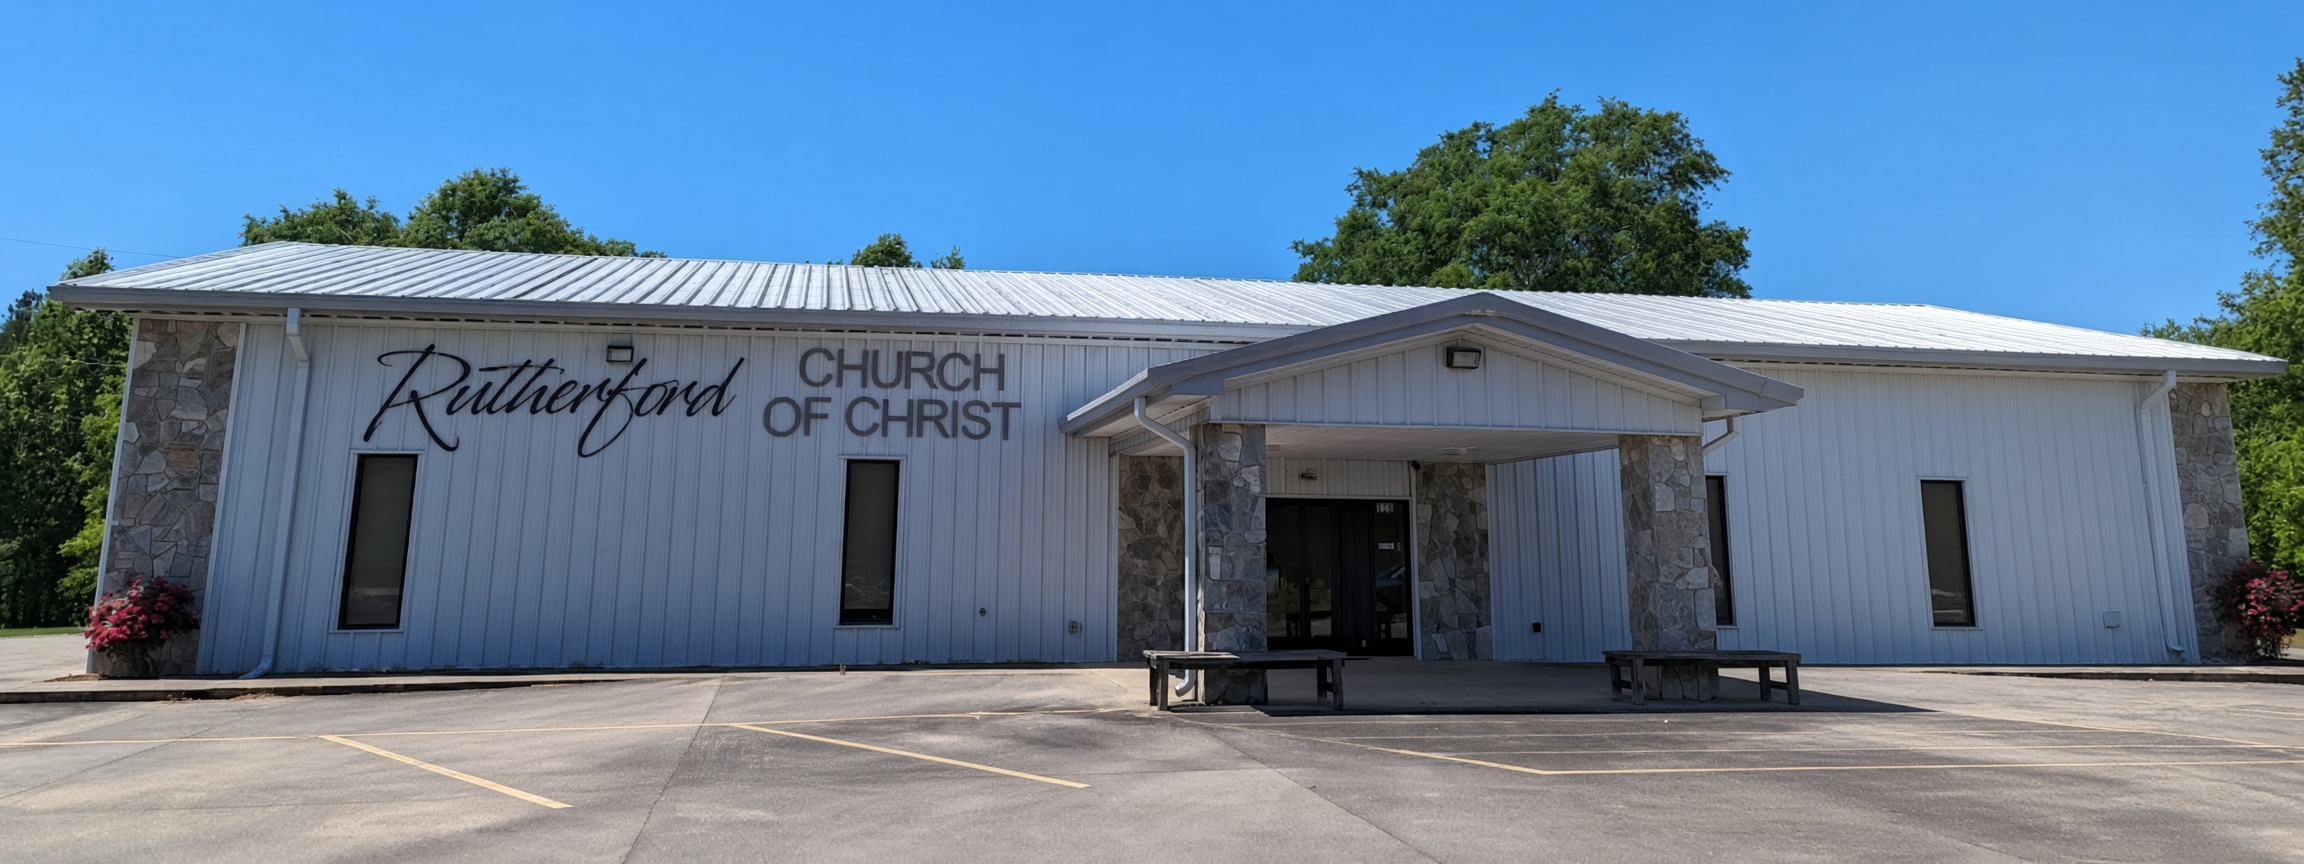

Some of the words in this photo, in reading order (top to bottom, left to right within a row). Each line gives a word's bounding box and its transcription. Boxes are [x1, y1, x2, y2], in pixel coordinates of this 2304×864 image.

[799, 347, 1005, 392] CHURCH
[363, 343, 745, 458] Rutherford
[763, 396, 832, 438] OF
[845, 395, 1022, 441] CHRIST
